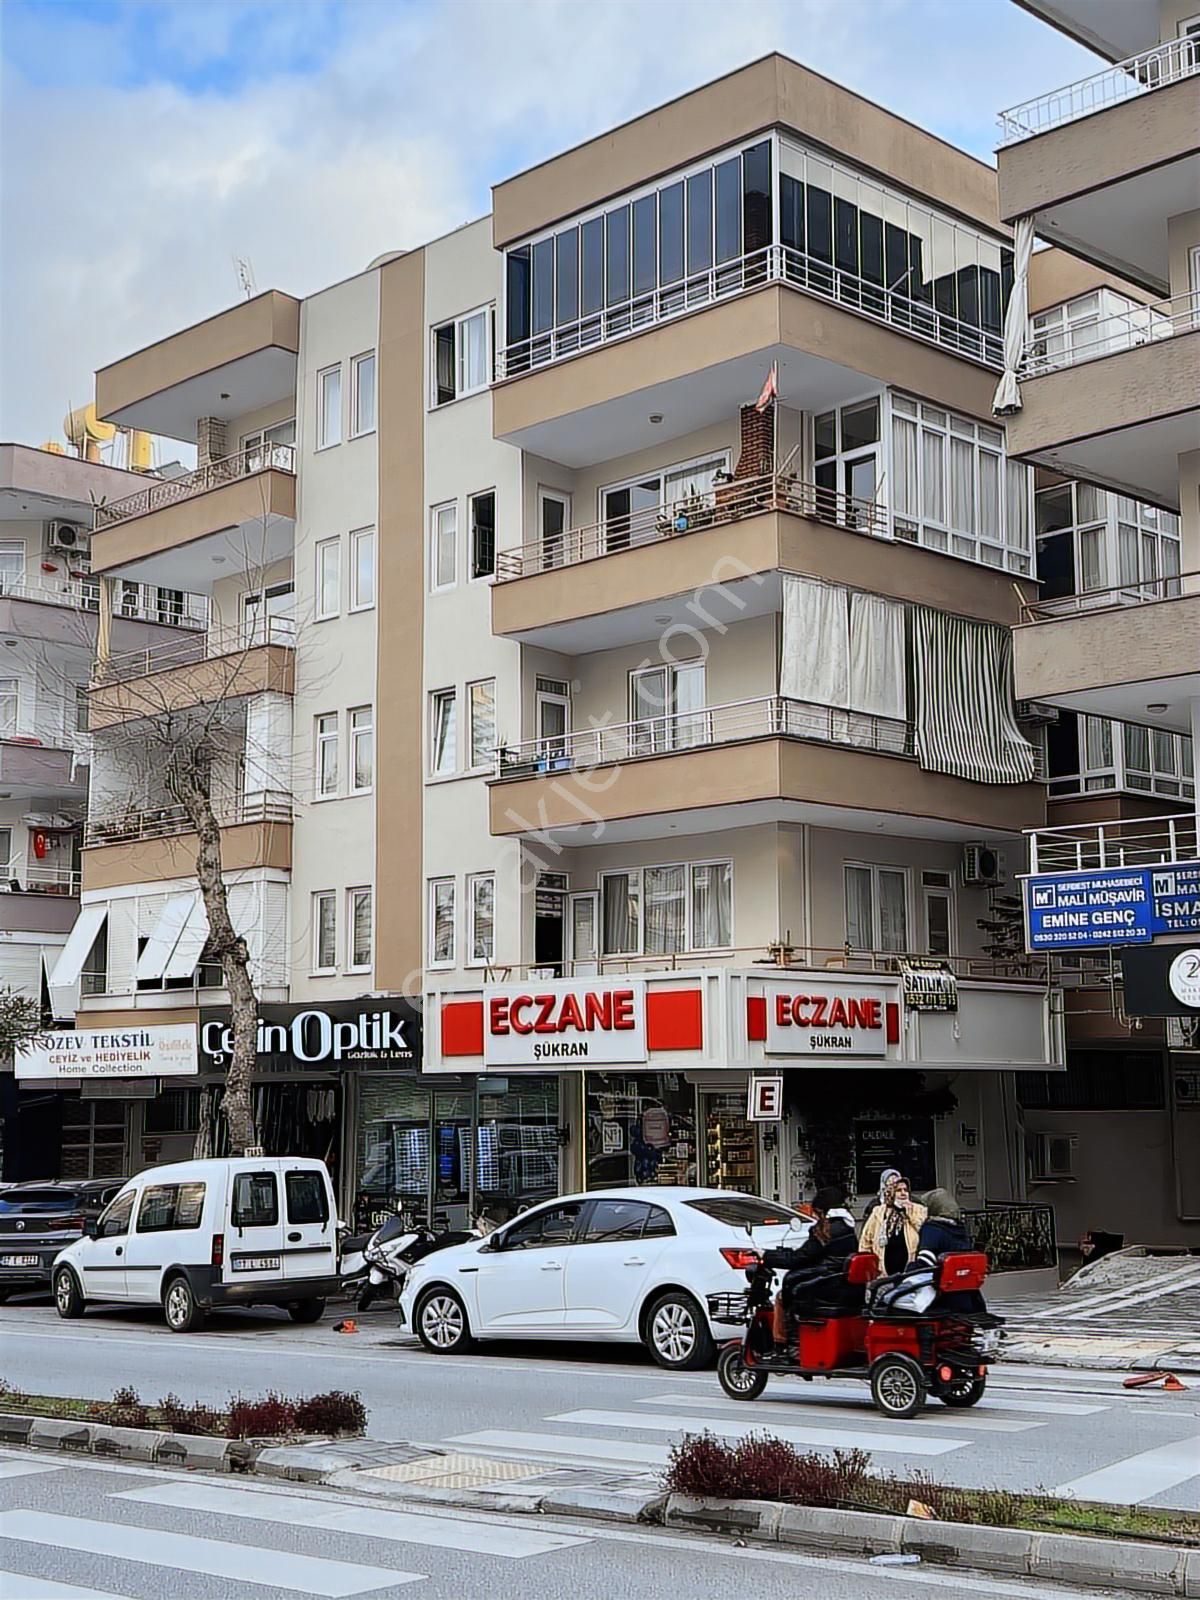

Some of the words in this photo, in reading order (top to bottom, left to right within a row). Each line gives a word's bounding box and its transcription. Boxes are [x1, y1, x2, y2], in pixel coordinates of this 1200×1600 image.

[1058, 891, 1087, 907] MALİ
[1089, 888, 1145, 907] MÜŞAVİR
[1042, 911, 1089, 928] EMİNE
[1091, 909, 1135, 926] GENÇ
[490, 989, 636, 1036] ECZANE
[776, 994, 883, 1030] ECZANE
[46, 1034, 84, 1050] ÖZEV
[91, 1029, 154, 1049] TEKSTİL
[202, 1018, 287, 1065] Çein
[290, 1010, 408, 1062] Optik
[810, 1034, 852, 1050] ŞÜKRAN
[96, 1050, 151, 1062] HEDİYELİK
[390, 1050, 413, 1058] Lens
[534, 1041, 589, 1060] ŞÜKRAN
[59, 1065, 87, 1073] Home
[92, 1064, 143, 1073] Collection
[760, 1086, 775, 1111] E
